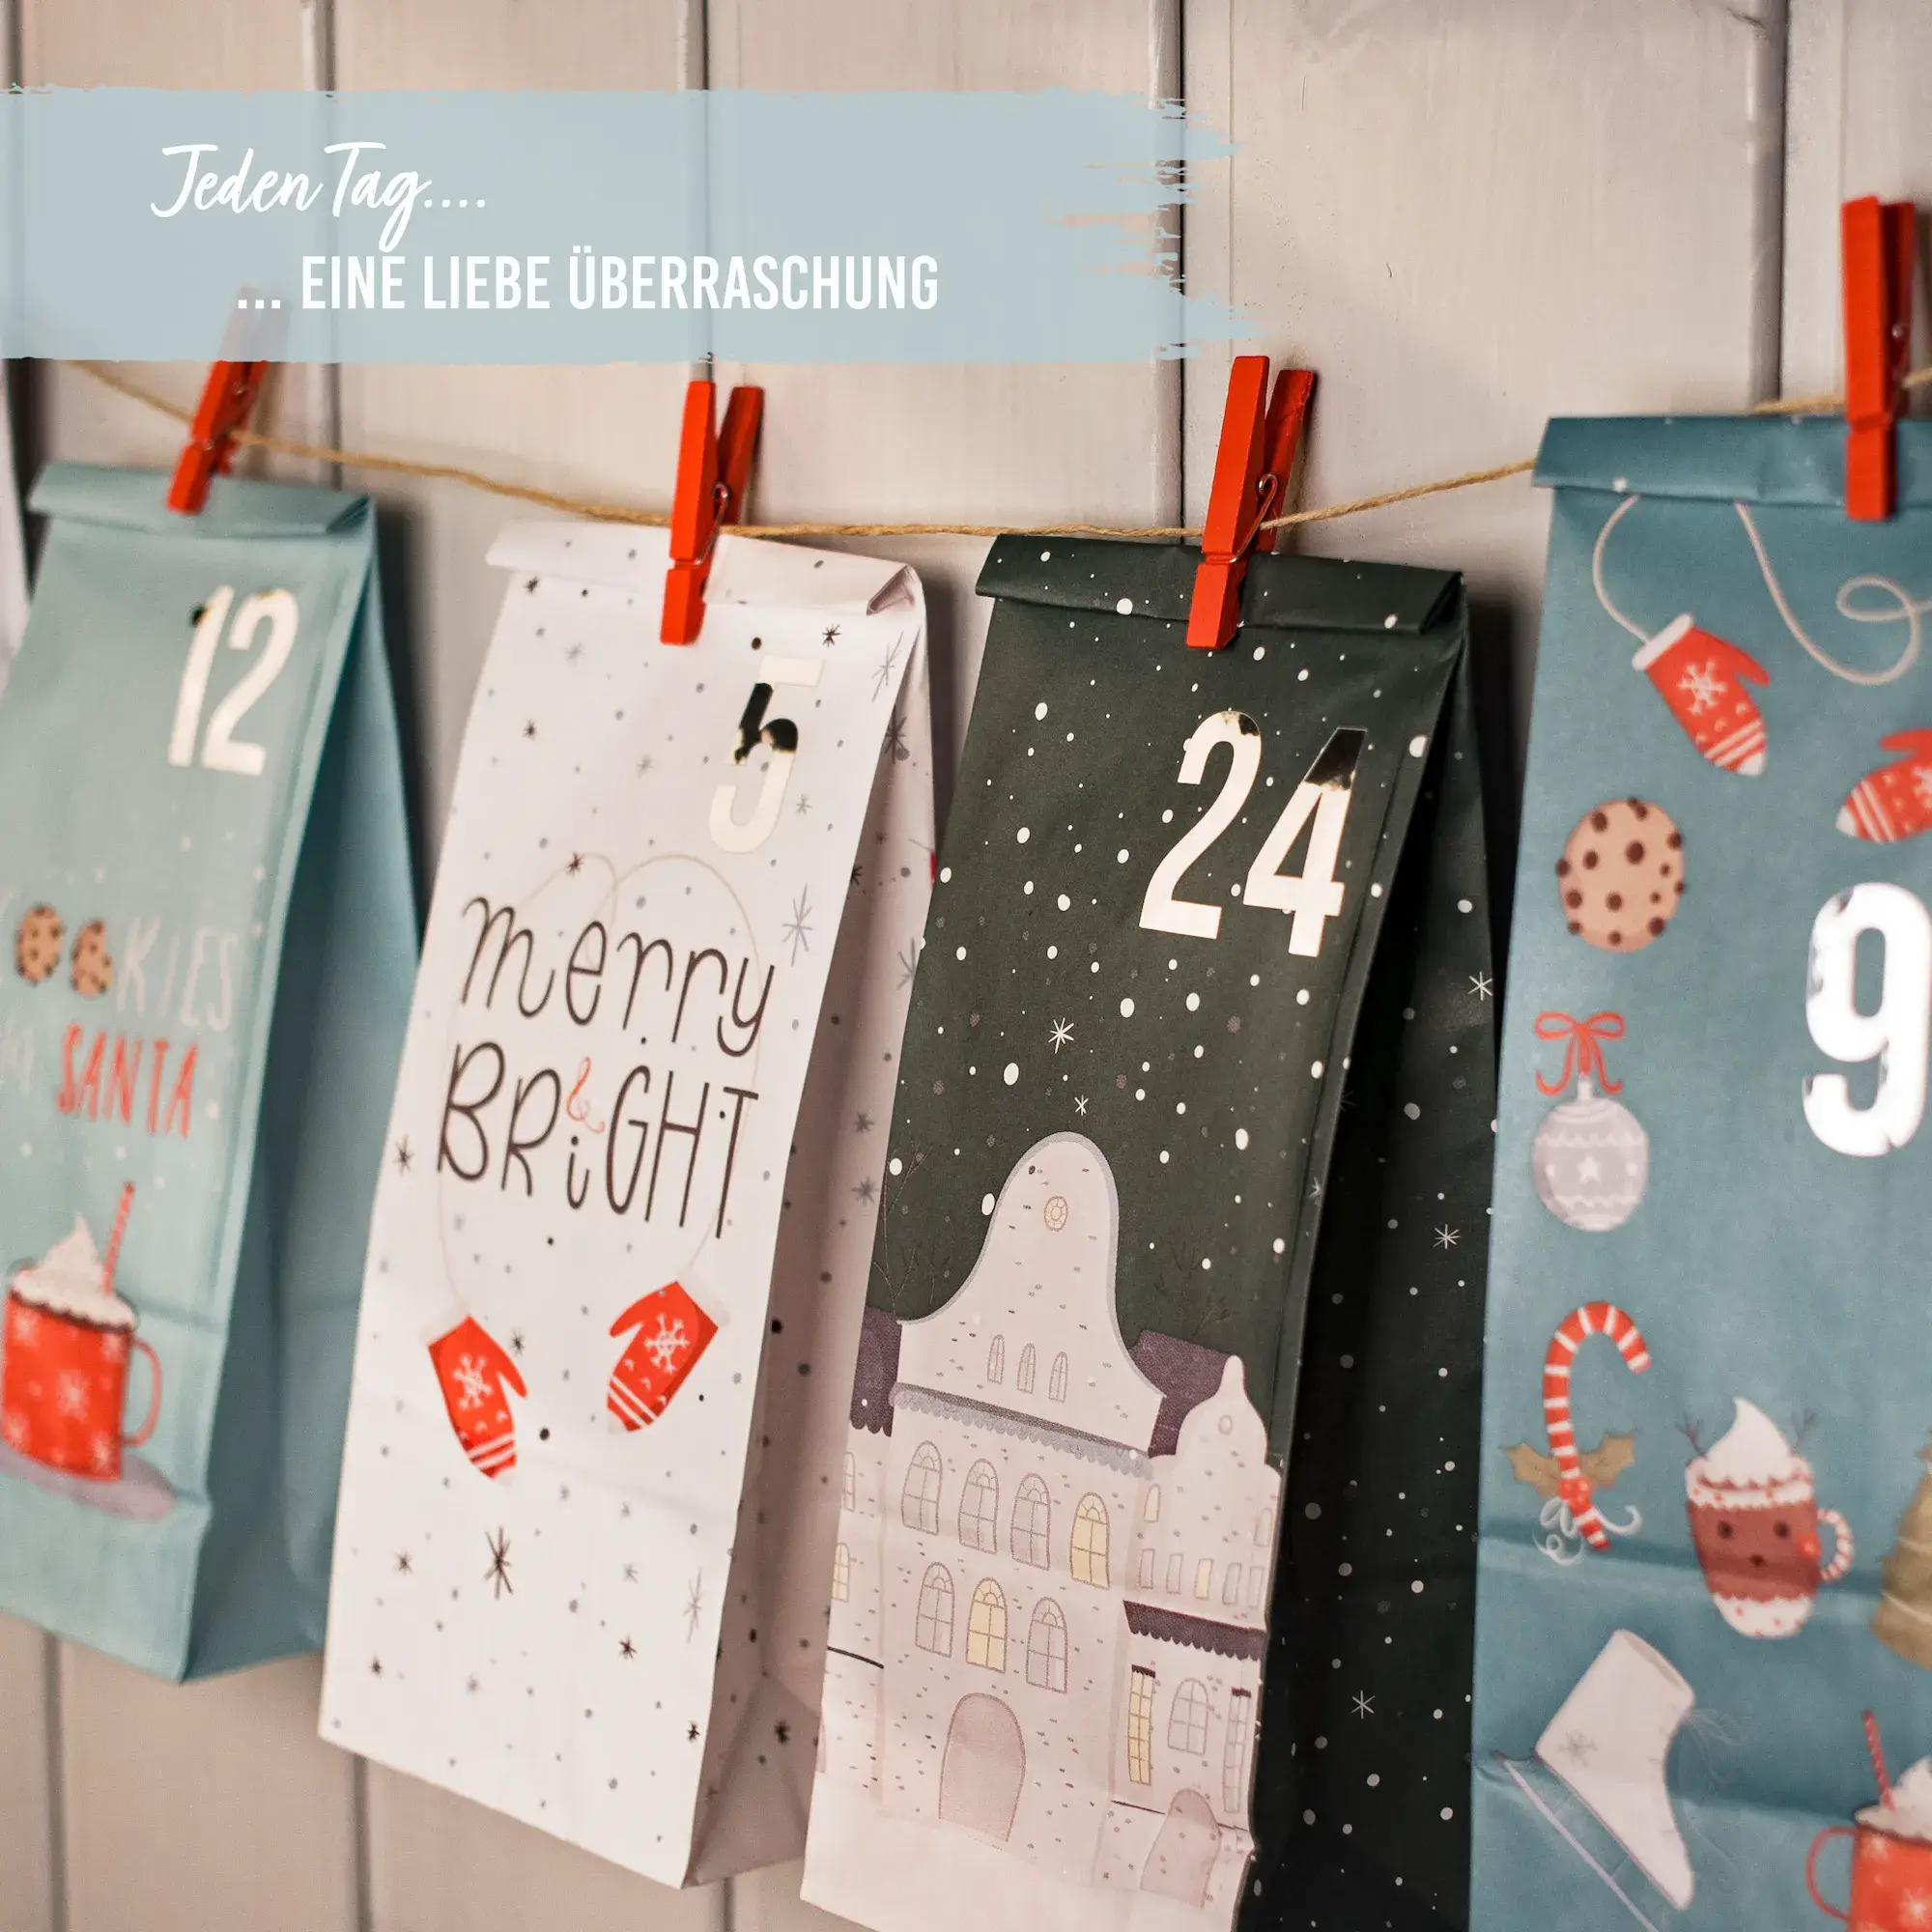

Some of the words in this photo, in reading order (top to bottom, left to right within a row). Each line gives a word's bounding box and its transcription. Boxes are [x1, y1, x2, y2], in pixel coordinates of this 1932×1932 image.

[166, 583, 299, 777] 12
[708, 654, 827, 855] 5
[1138, 709, 1369, 958] 24
[55, 1021, 199, 1141] SANTA
[565, 1056, 607, 1135] &
[1802, 881, 1932, 1157] 9
